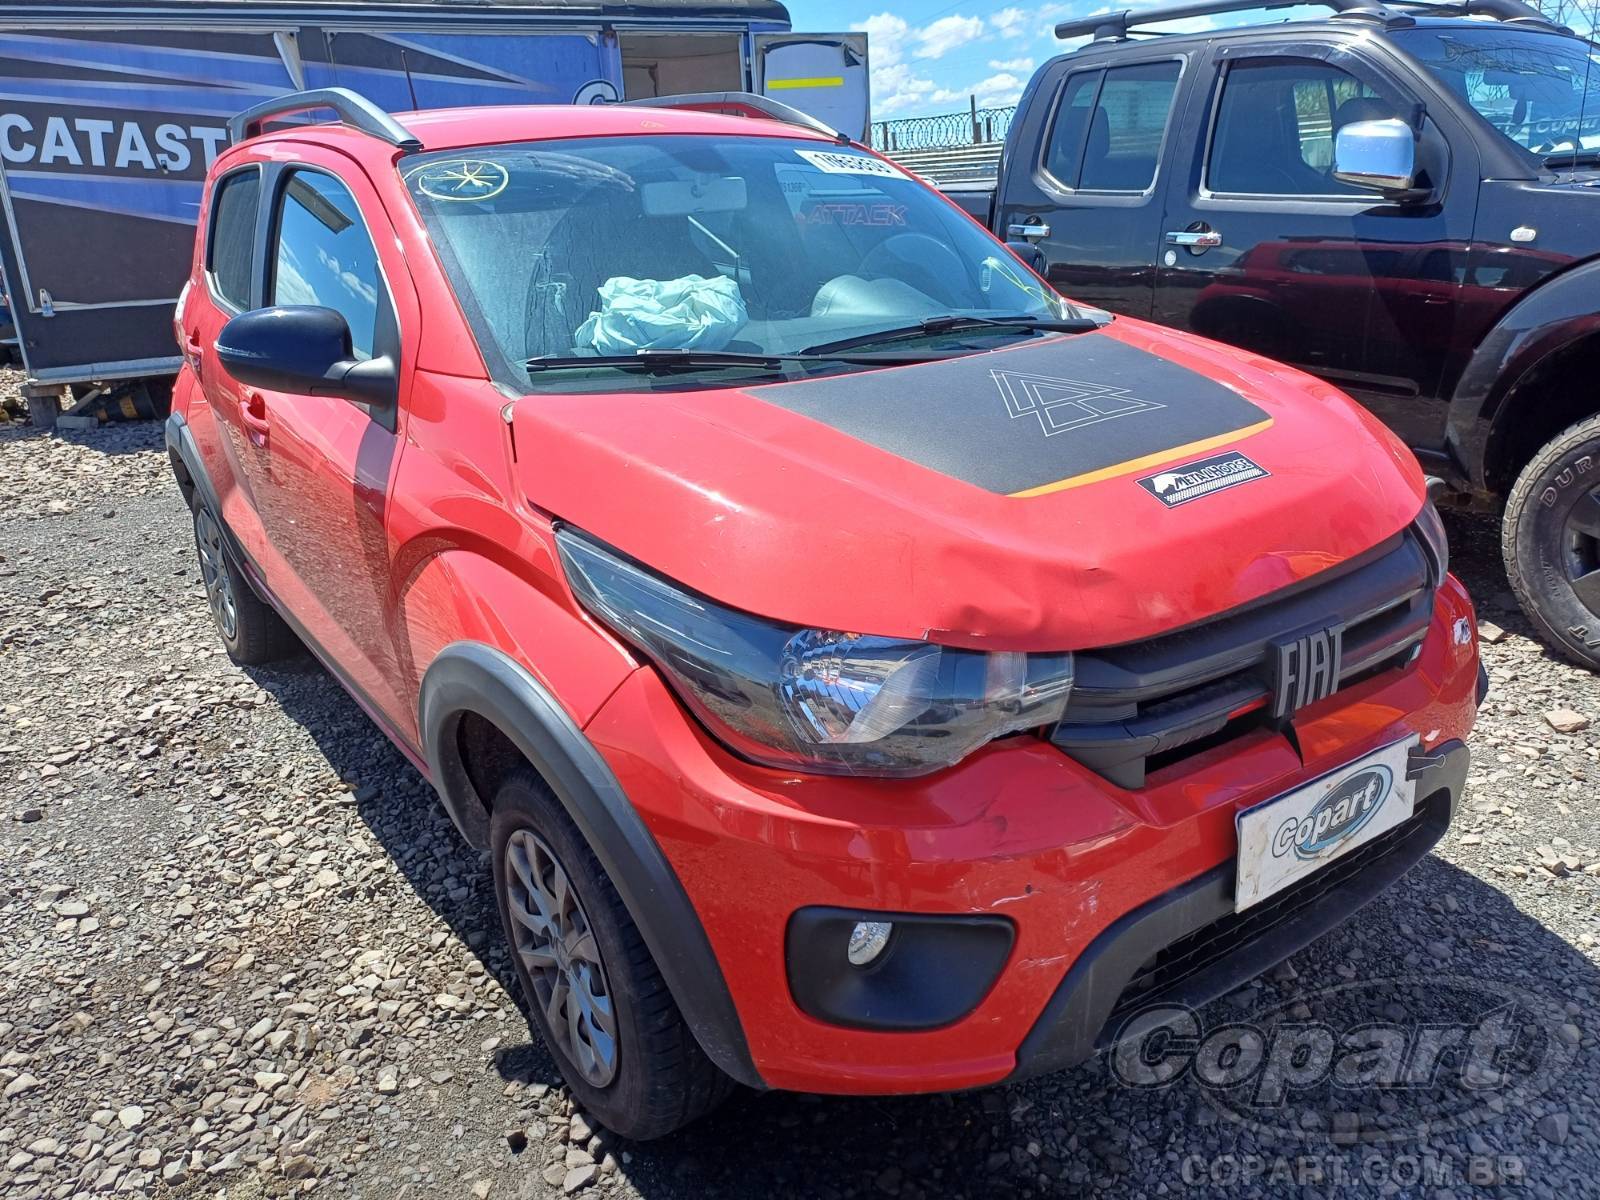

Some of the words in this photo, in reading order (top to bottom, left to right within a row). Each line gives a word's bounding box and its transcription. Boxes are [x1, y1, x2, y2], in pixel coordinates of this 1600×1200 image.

[806, 203, 908, 226] ATTACK
[1277, 623, 1346, 719] FIAT
[1272, 771, 1378, 858] Copart
